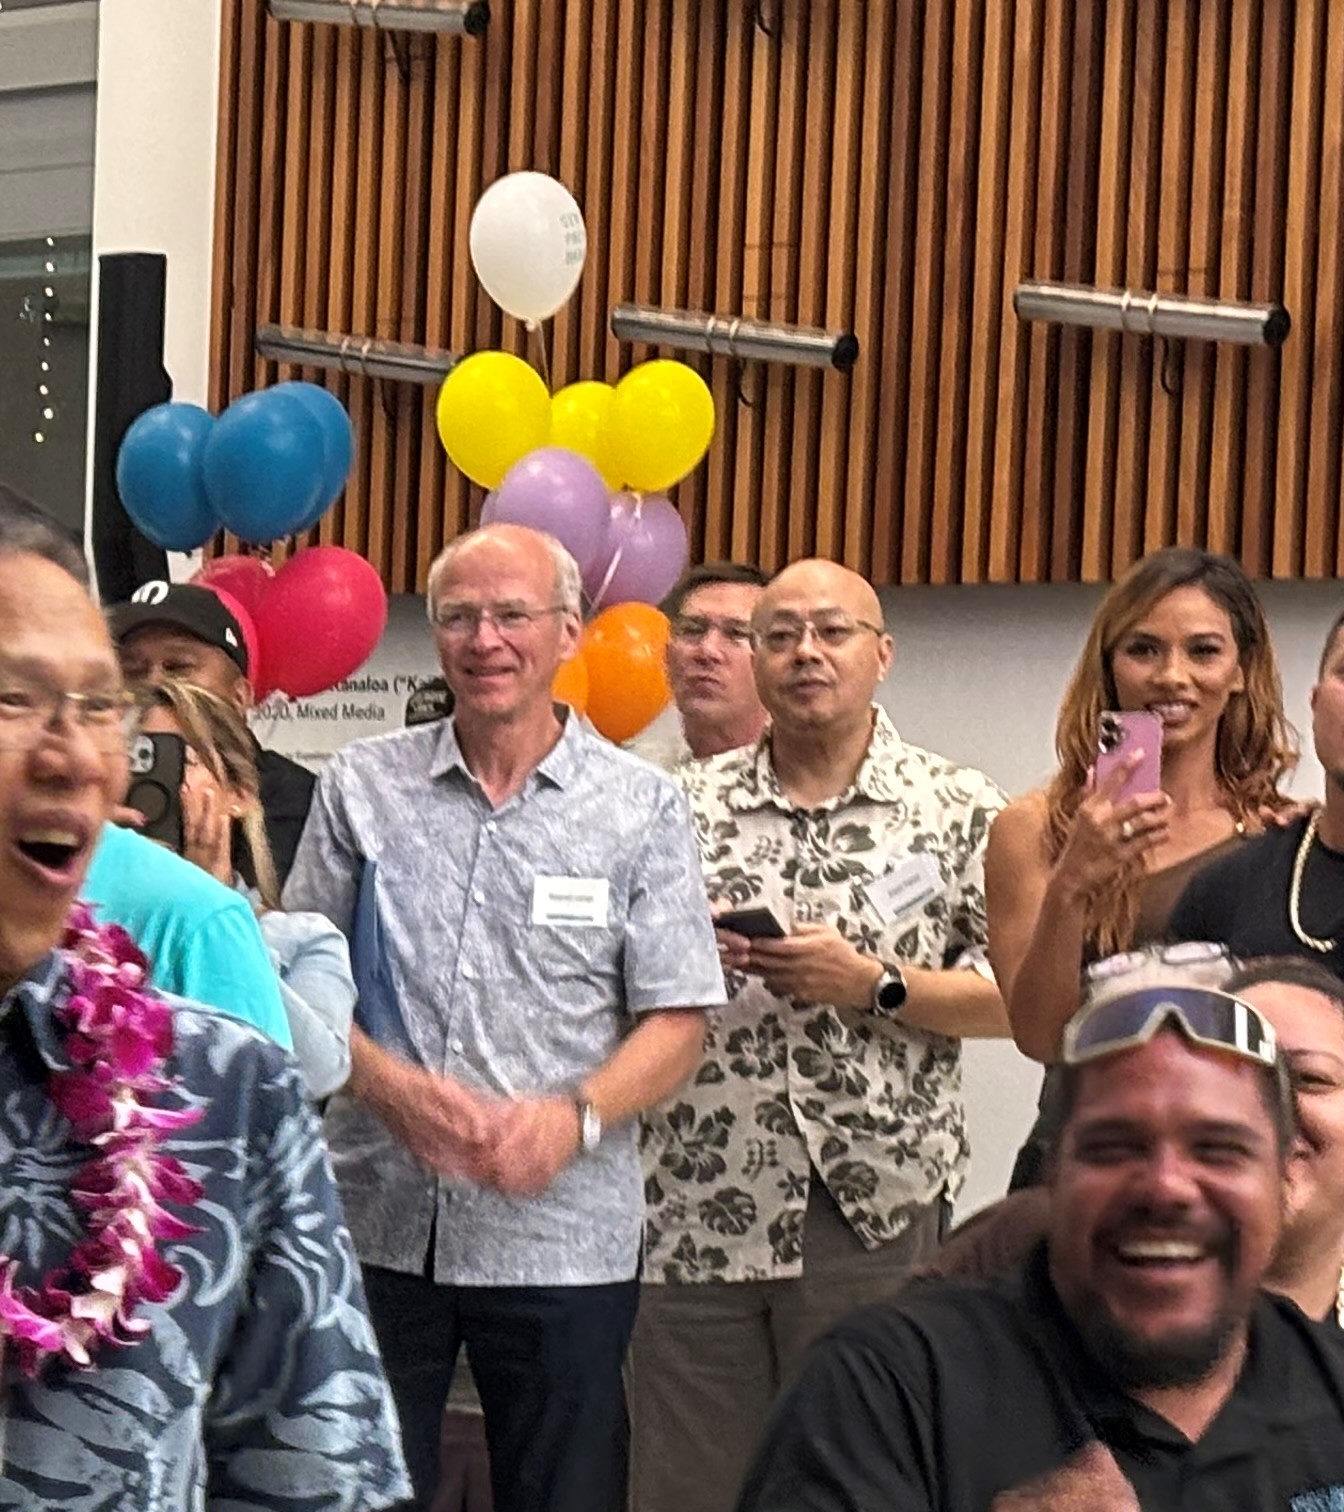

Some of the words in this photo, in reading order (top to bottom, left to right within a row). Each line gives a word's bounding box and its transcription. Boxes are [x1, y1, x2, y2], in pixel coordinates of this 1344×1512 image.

[334, 675, 389, 692] analoa
[297, 702, 338, 721] Mixed
[342, 703, 386, 722] Media
